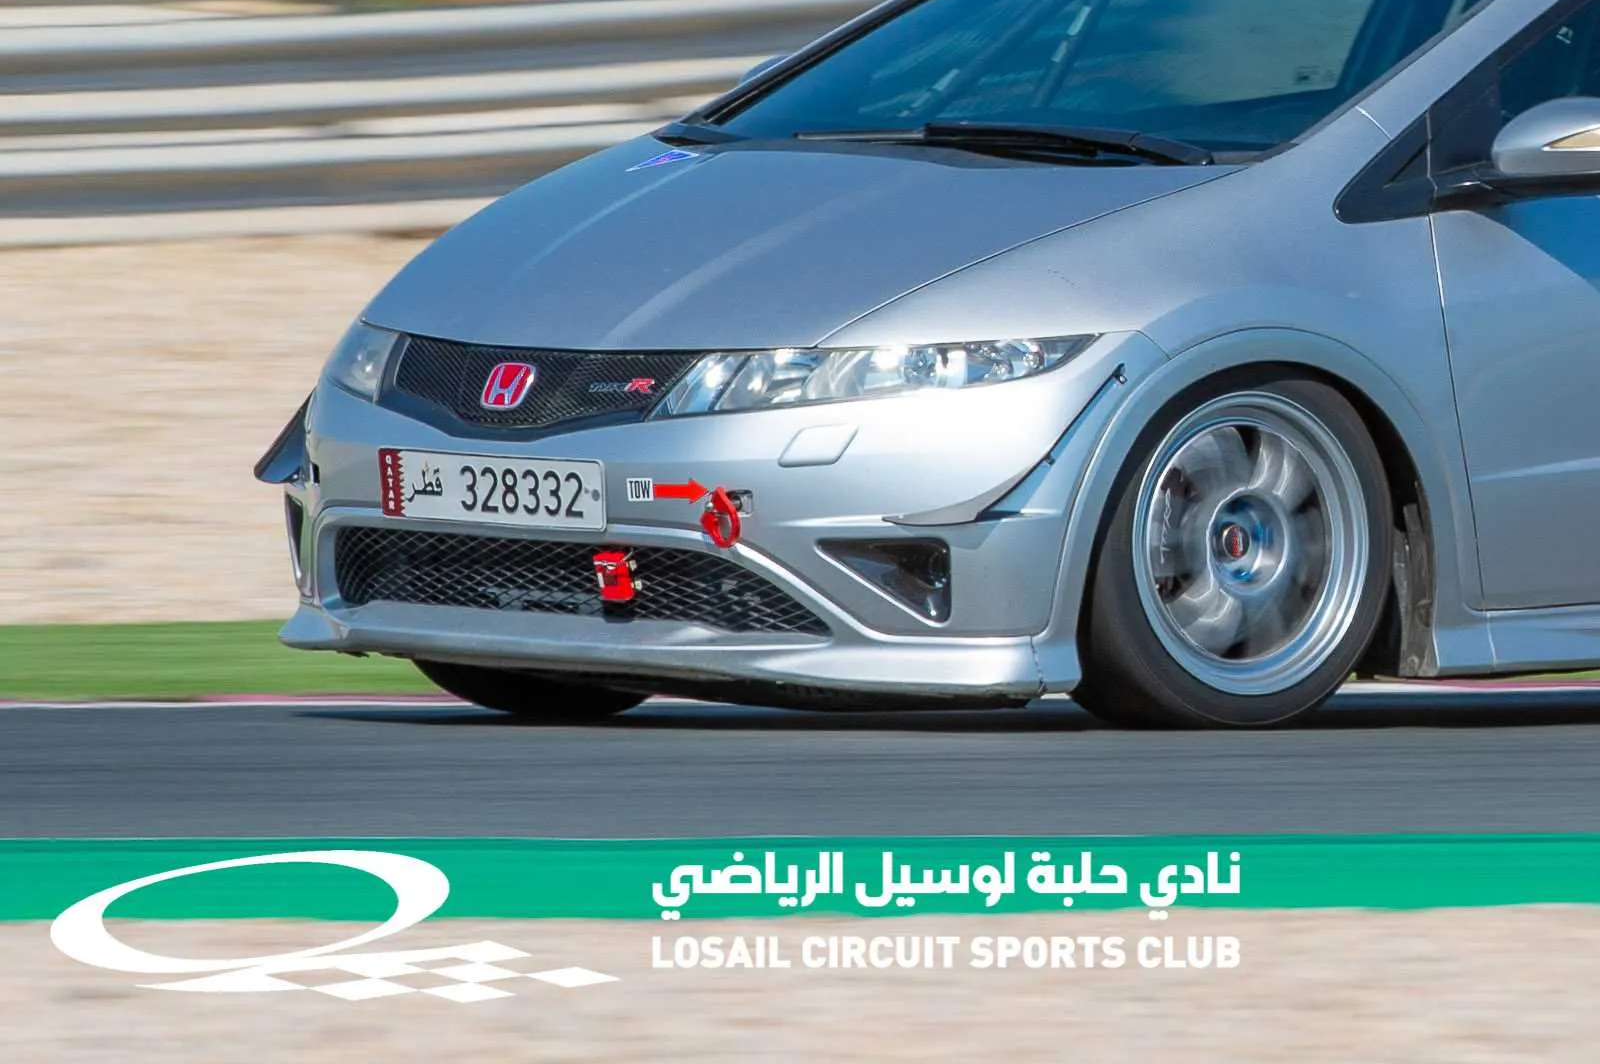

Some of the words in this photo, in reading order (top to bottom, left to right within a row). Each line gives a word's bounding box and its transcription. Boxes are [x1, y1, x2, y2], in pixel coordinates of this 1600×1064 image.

[385, 455, 395, 510] QATAR
[405, 467, 443, 503] قطر
[459, 464, 584, 518] 328332
[628, 479, 652, 500] TOW
